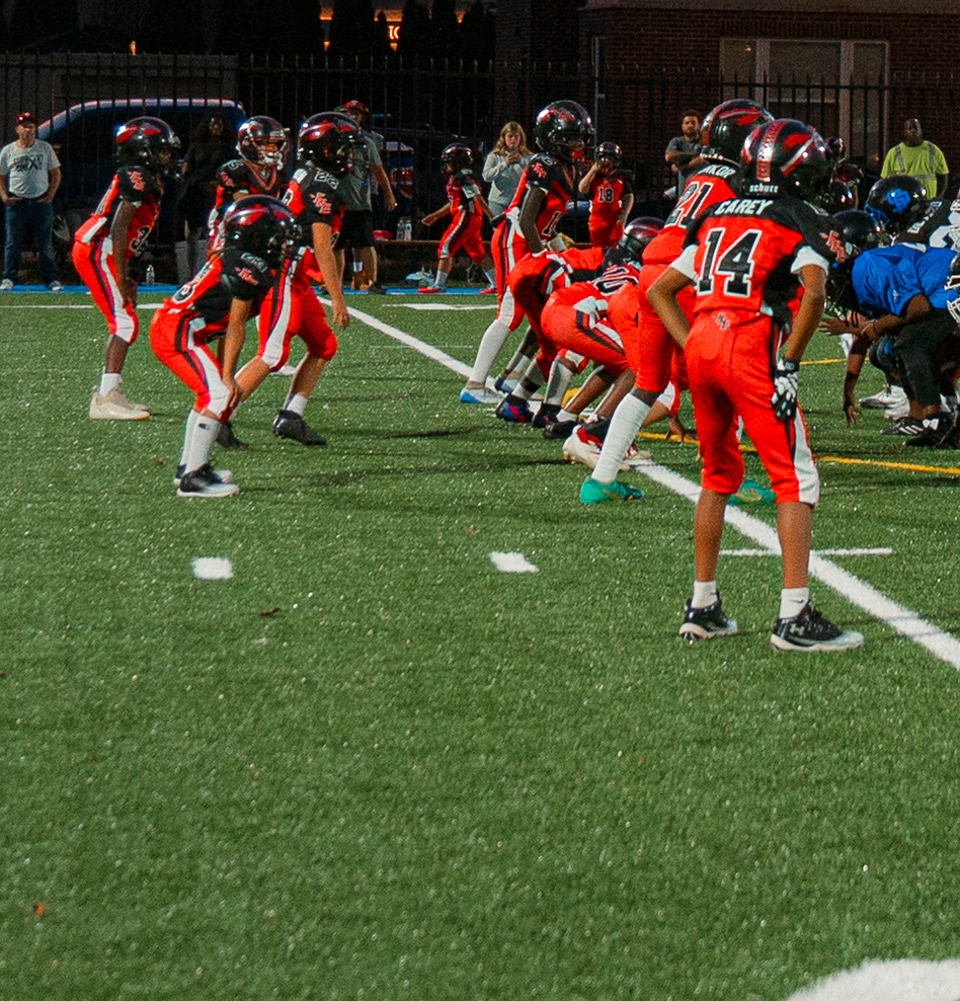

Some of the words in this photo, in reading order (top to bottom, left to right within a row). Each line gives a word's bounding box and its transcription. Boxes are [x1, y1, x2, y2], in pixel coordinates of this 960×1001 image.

[598, 186, 614, 203] 18
[664, 182, 714, 228] 21
[715, 199, 773, 215] CAREY
[699, 227, 762, 297] 14
